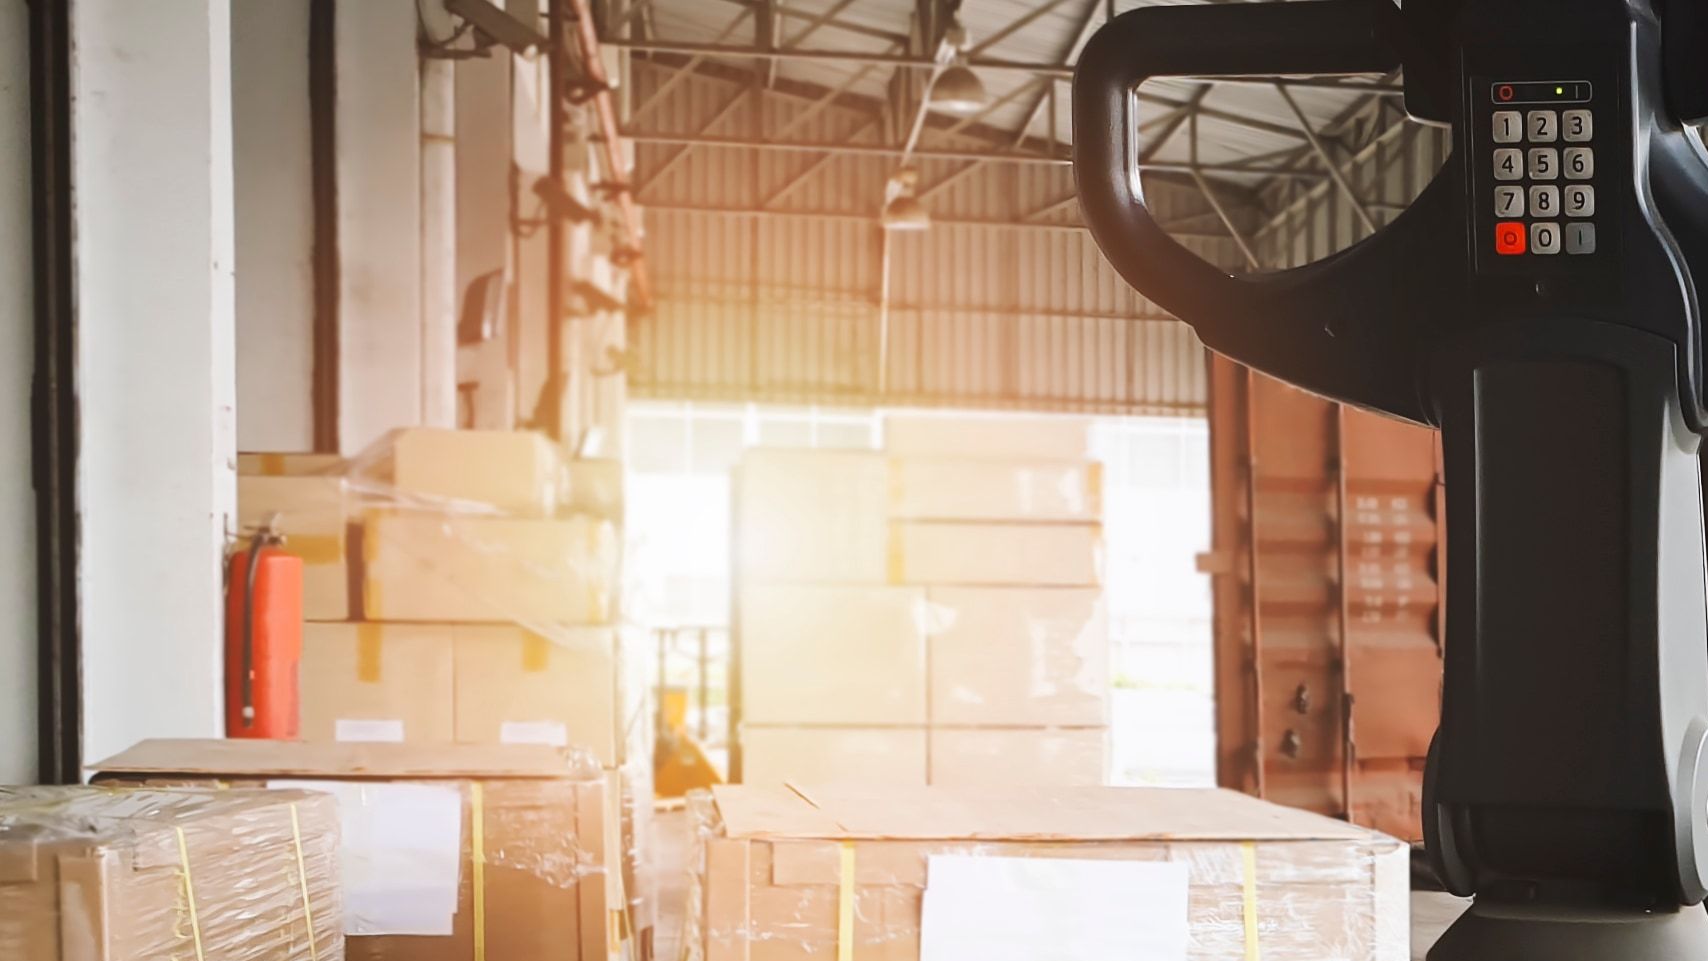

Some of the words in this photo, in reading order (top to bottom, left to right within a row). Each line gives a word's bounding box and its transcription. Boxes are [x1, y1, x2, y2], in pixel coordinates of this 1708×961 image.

[1503, 117, 1510, 137] 1
[1536, 117, 1548, 136] 2
[1571, 116, 1583, 135] 3
[1501, 155, 1514, 173] 4
[1537, 154, 1549, 173] 5
[1572, 154, 1584, 173] 6
[1503, 192, 1515, 211] 7
[1538, 191, 1550, 210] 8
[1572, 191, 1585, 210] 9
[1538, 228, 1552, 248] 0
